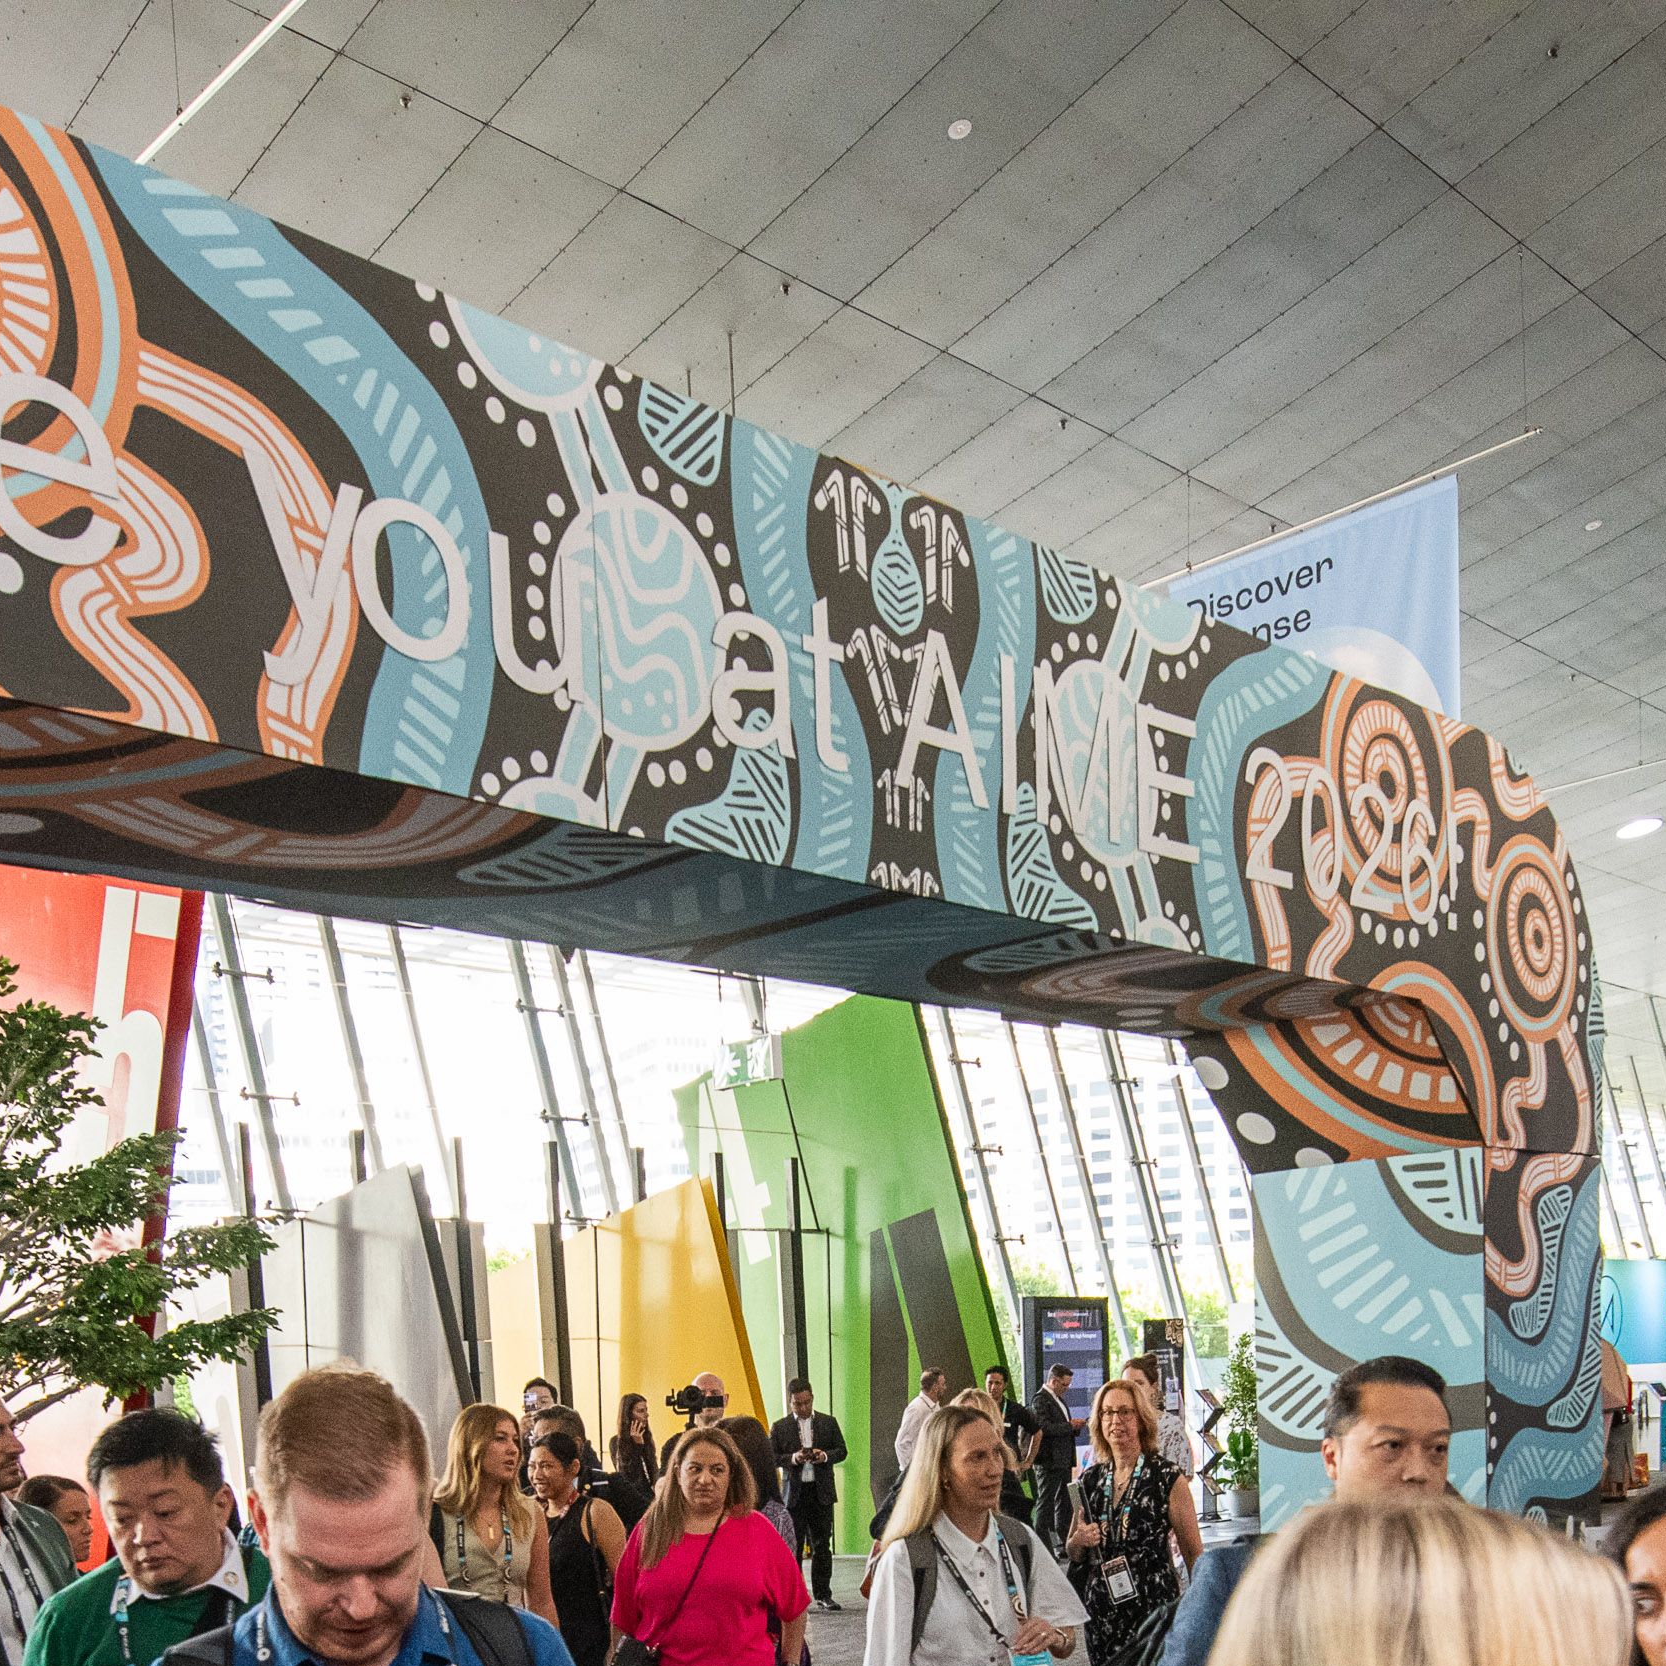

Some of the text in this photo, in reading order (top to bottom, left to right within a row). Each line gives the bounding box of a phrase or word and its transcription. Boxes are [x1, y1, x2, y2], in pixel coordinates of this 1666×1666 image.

[243, 452, 586, 703] you
[711, 597, 849, 772] at
[895, 629, 1200, 865] AIME
[1244, 746, 1459, 932] 2026!
